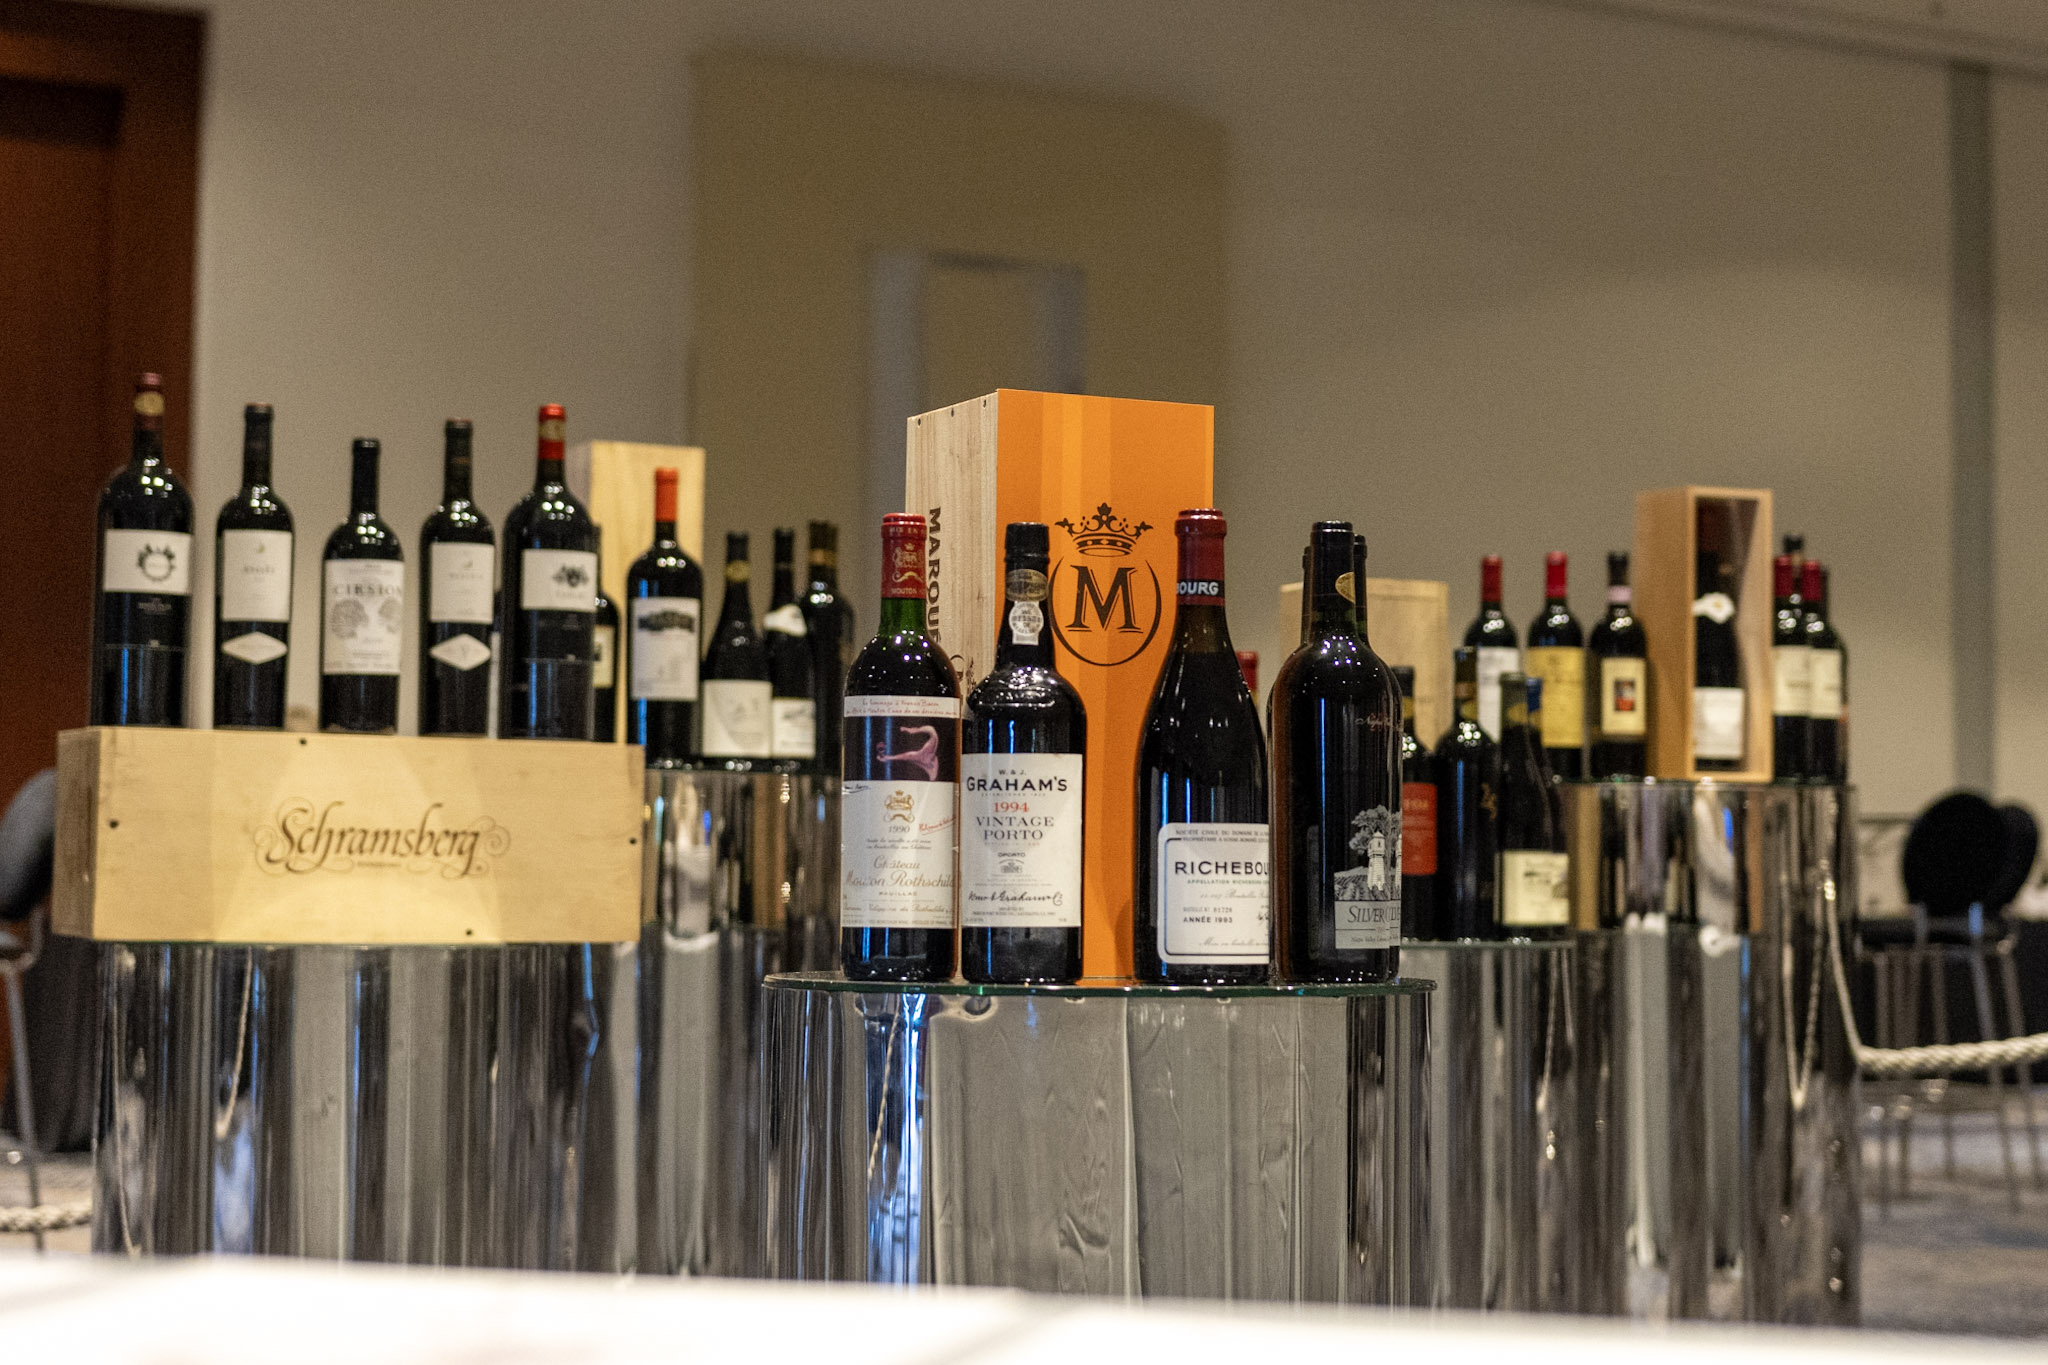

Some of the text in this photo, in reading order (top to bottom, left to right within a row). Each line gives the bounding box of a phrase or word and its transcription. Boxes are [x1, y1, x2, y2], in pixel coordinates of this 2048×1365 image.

[1176, 581, 1219, 596] OURG
[1065, 564, 1144, 634] M
[966, 776, 1068, 791] GRAHAM'S
[994, 802, 1029, 813] 1994
[976, 816, 1054, 827] VINTAGE
[888, 825, 911, 834] 1990
[984, 829, 1043, 840] PORTO
[1183, 915, 1211, 923] ANNÉE
[1347, 905, 1386, 923] SILVER
